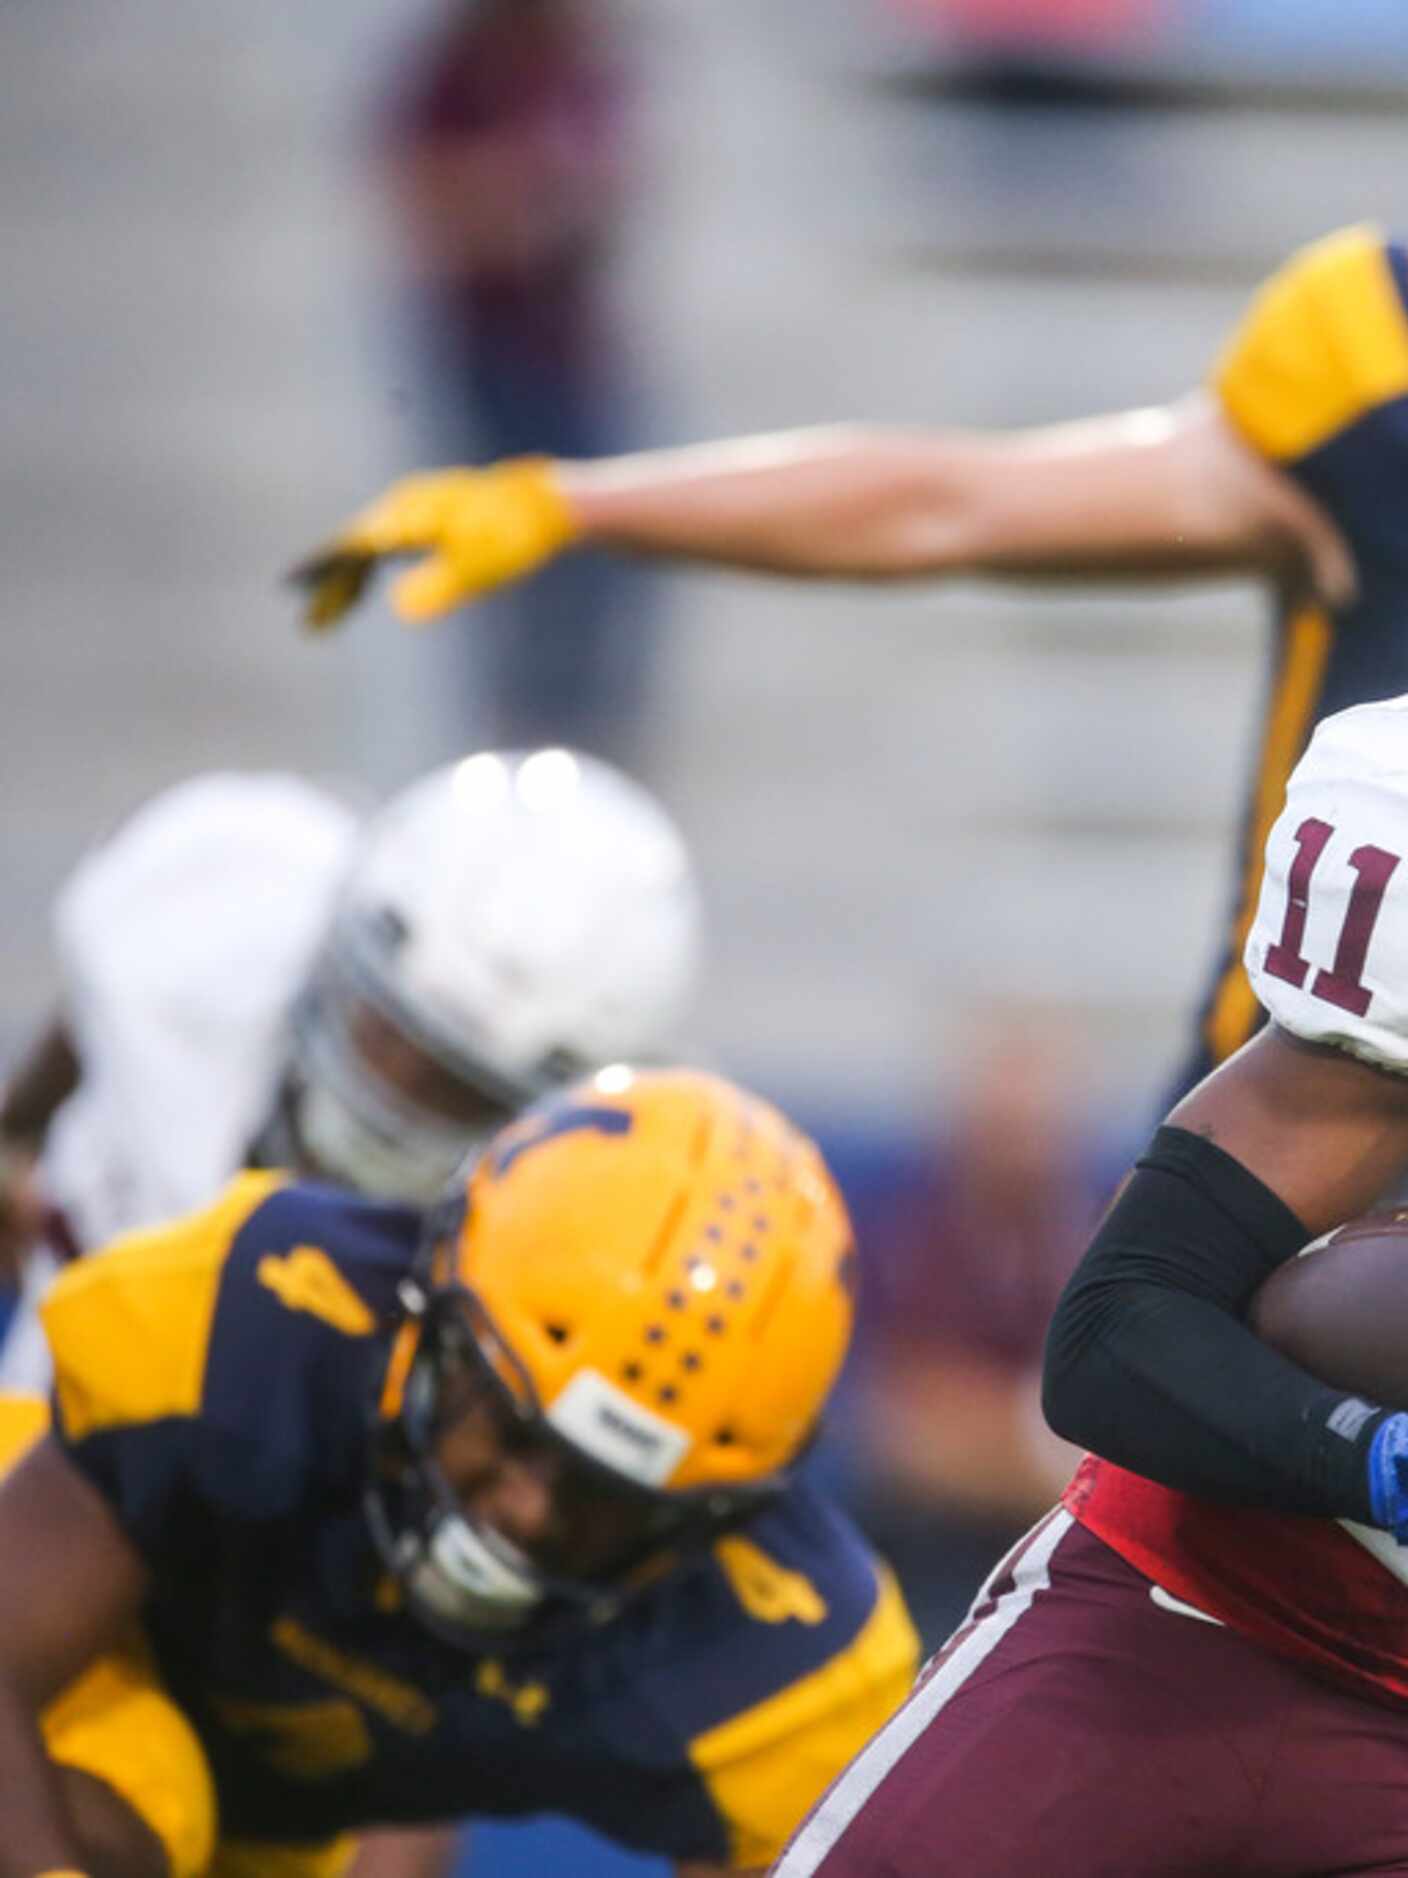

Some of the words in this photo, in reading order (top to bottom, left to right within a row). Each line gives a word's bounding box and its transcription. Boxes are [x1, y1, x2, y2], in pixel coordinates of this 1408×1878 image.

[1263, 816, 1401, 1018] 11
[257, 1247, 375, 1336] 4
[714, 1536, 827, 1626] 4
